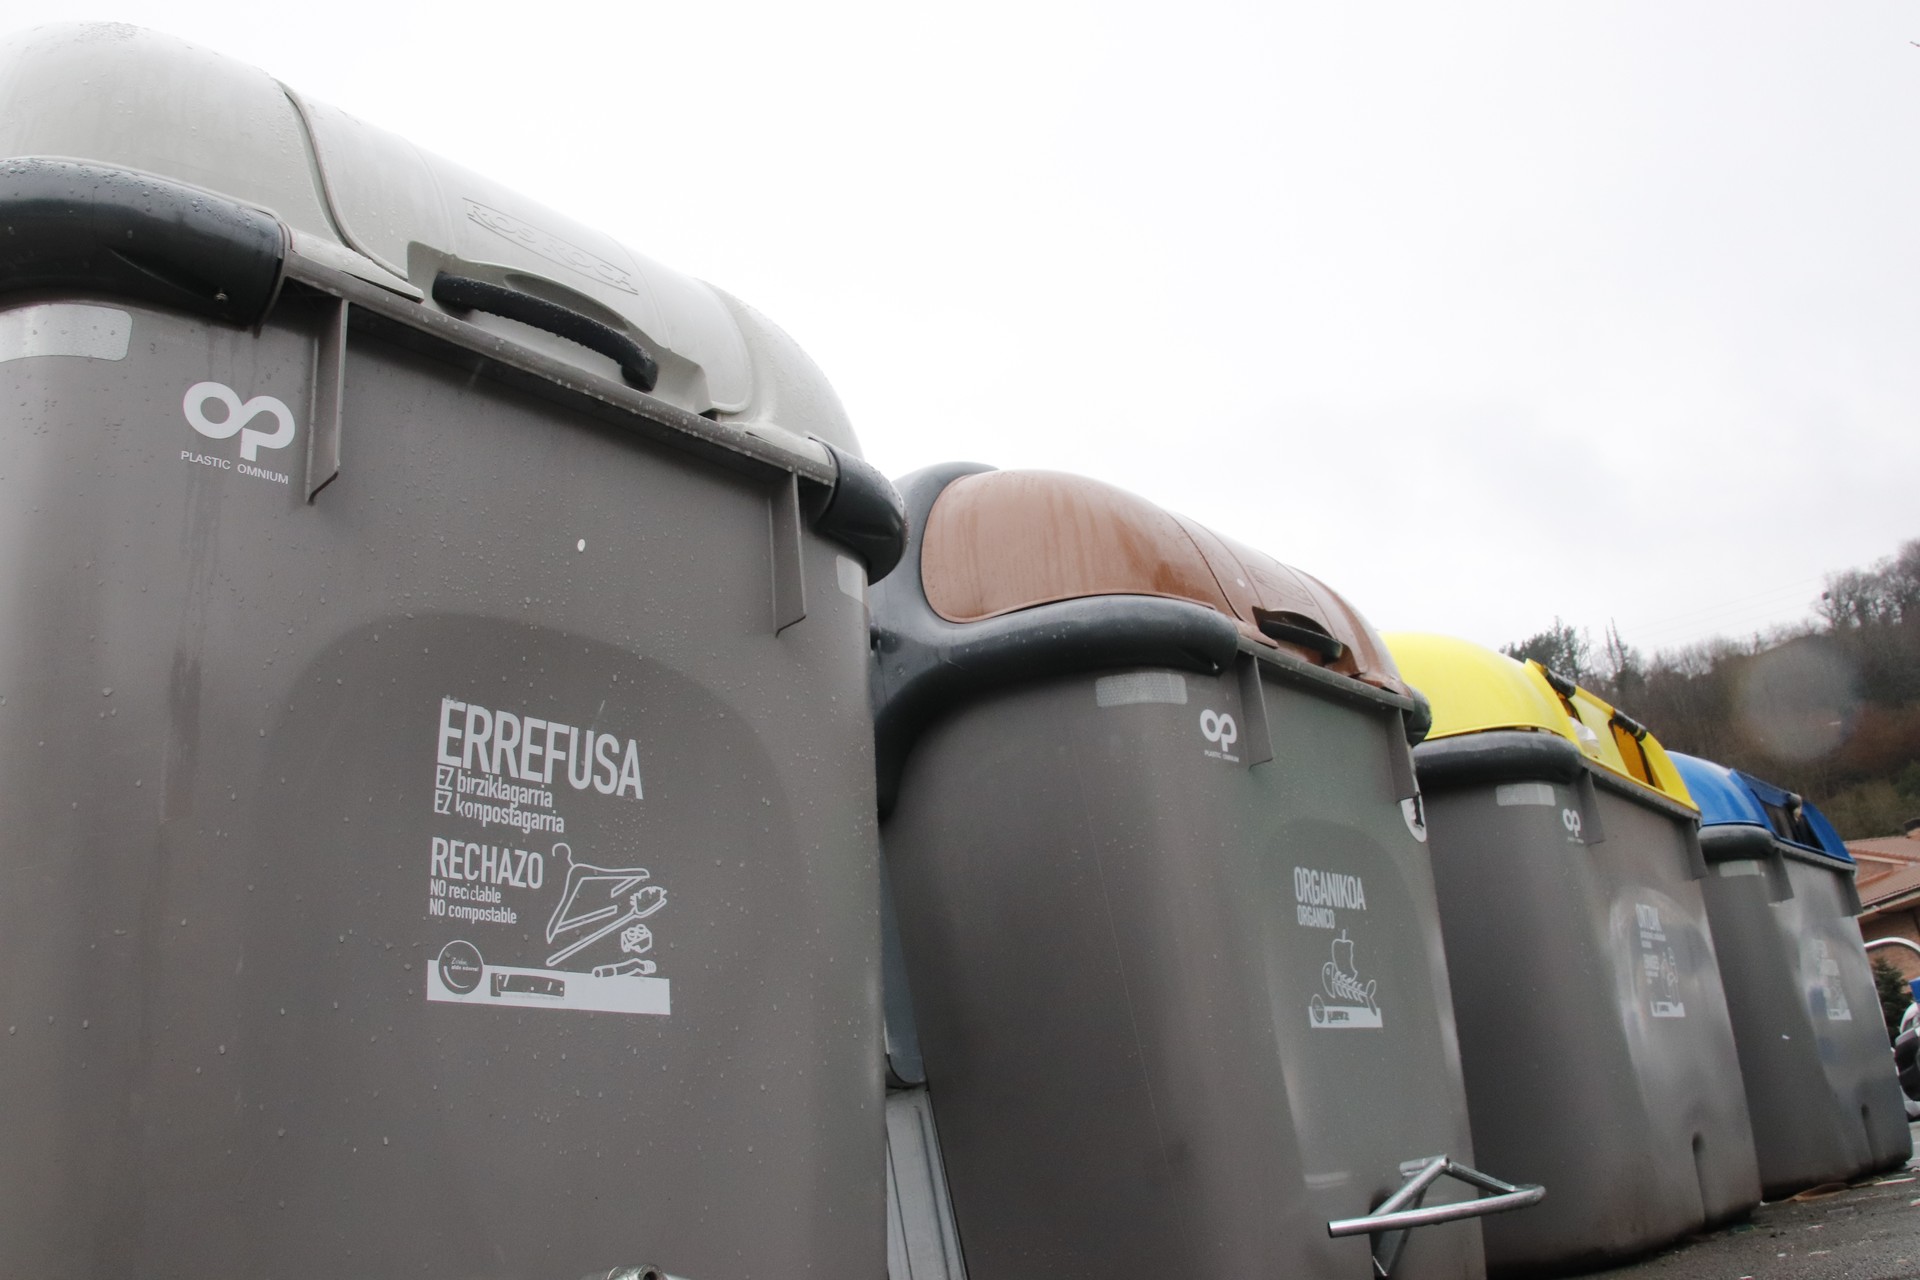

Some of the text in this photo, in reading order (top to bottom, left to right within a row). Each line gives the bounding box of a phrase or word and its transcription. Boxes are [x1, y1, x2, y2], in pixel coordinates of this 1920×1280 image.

[181, 450, 289, 484] PLASTIC OMNIUM
[437, 698, 643, 800] ERREFUSA
[436, 764, 553, 808] EZ birziklagarria
[434, 789, 565, 834] EZ konpostagarria
[430, 837, 543, 889] RECHAZO
[430, 878, 502, 904] NO reciclable
[1294, 866, 1367, 911] ORGANIKOA
[429, 898, 518, 924] NO compostable
